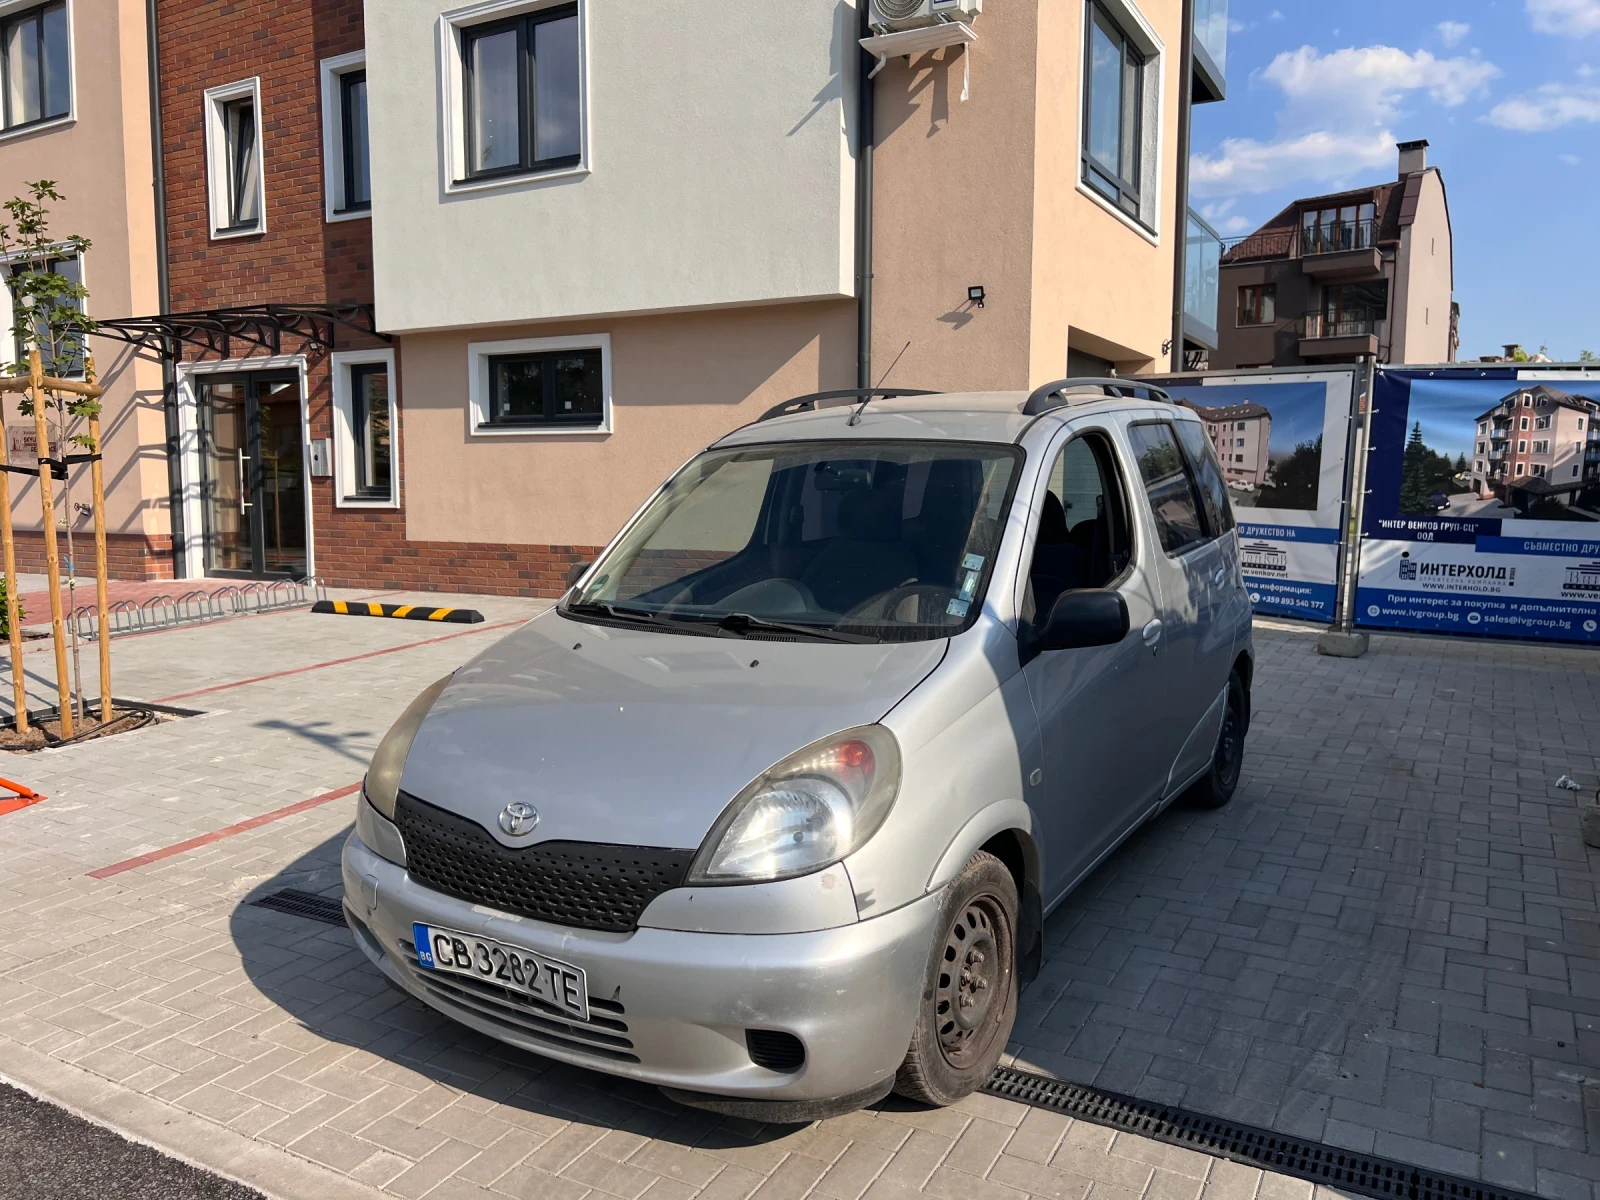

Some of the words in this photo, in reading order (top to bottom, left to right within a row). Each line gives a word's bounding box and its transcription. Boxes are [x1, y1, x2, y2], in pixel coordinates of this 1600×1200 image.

[1378, 519, 1406, 529] "ИНТЕР
[1408, 520, 1438, 530] ВЕНКОВ
[1441, 522, 1479, 532] ГРУП-СЦ"
[1246, 526, 1284, 537] ДРУЖЕСТВО
[1286, 529, 1296, 538] НА
[1417, 532, 1434, 541] ООД
[1524, 541, 1578, 552] СЪВМЕСТНО
[1581, 544, 1600, 554] ДРУ
[1420, 563, 1506, 579] ИНТЕРХОЛД
[1260, 582, 1312, 594] информация:
[1422, 583, 1500, 592] WWW.INTERHOLD.BG
[1561, 591, 1600, 600] www.ve
[1262, 595, 1280, 603] +359
[1280, 598, 1294, 606] 893
[1296, 599, 1309, 607] 540
[1310, 601, 1324, 609] 377
[1388, 594, 1407, 604] При
[1409, 597, 1448, 607] интерес
[1450, 599, 1462, 607] за
[1464, 600, 1506, 611] покупка
[1520, 604, 1596, 615] допълнителна
[1382, 606, 1459, 621] www.ivgroup.bg
[1484, 614, 1571, 629] sales@ivgroup.bg
[420, 951, 432, 962] BG
